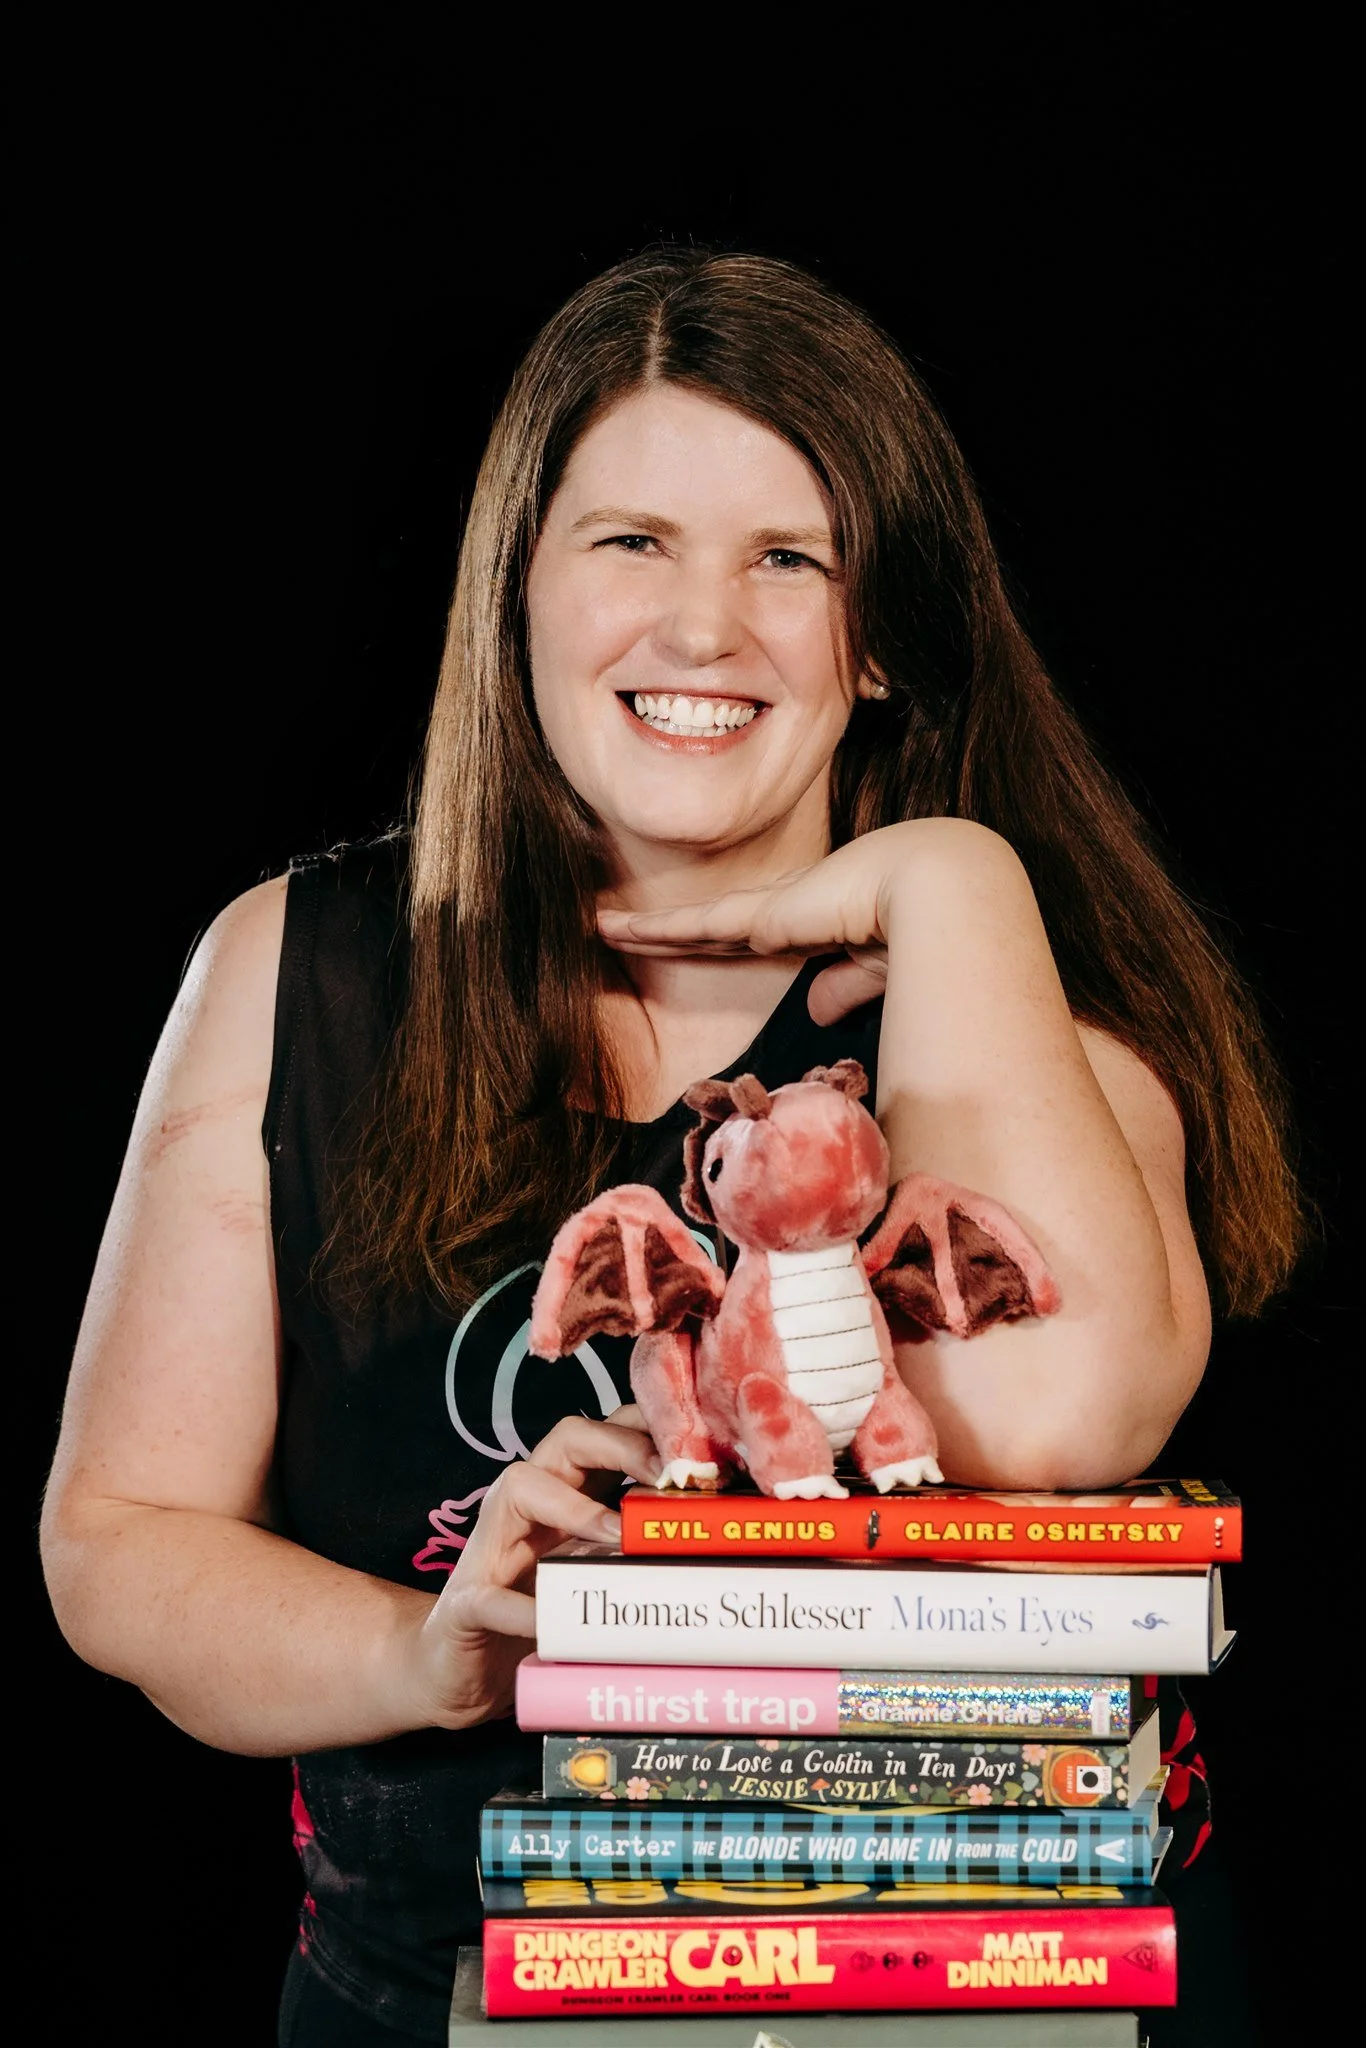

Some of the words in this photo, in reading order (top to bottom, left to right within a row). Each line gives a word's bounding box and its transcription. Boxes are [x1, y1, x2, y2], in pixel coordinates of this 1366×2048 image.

[643, 1520, 710, 1540] EVIL
[722, 1520, 836, 1540] GENIUS
[904, 1522, 1014, 1541] CLAIRE
[1026, 1522, 1183, 1542] OSHETSKY
[572, 1589, 708, 1627] Thomas
[719, 1591, 872, 1630] Schlesser
[890, 1595, 1007, 1632] Mona's
[1018, 1596, 1093, 1646] Eyes
[587, 1685, 709, 1723] thirst
[722, 1688, 817, 1731] trap
[631, 1744, 688, 1772] How
[692, 1754, 712, 1772] to
[717, 1745, 773, 1774] Lose
[780, 1758, 793, 1774] a
[804, 1749, 874, 1775] Goblin
[884, 1750, 907, 1776] in
[918, 1752, 956, 1778] Ten
[965, 1756, 1016, 1786] Days
[729, 1775, 809, 1800] JESSIE
[830, 1778, 897, 1800] SYLVA
[508, 1833, 572, 1860] Ally
[584, 1834, 677, 1858] Carter
[692, 1841, 717, 1857] THE
[718, 1835, 803, 1861] BLONDE
[808, 1836, 857, 1862] WHO
[862, 1836, 923, 1863] CAME
[927, 1837, 953, 1862] IN
[955, 1842, 992, 1858] FROM
[994, 1843, 1019, 1859] THE
[1022, 1838, 1079, 1863] COLD
[513, 1930, 667, 1961] DUNGEON
[669, 1926, 836, 1988] CARL
[982, 1931, 1064, 1961] MATT
[513, 1957, 669, 1991] CRAWLER
[947, 1957, 1108, 1988] DINNIMAN
[561, 1995, 625, 2006] DUNGEON
[628, 1994, 684, 2005] CRAWLER
[688, 1993, 719, 2003] CARL
[723, 1992, 760, 2002] BOOK
[765, 1991, 791, 2001] ONE
